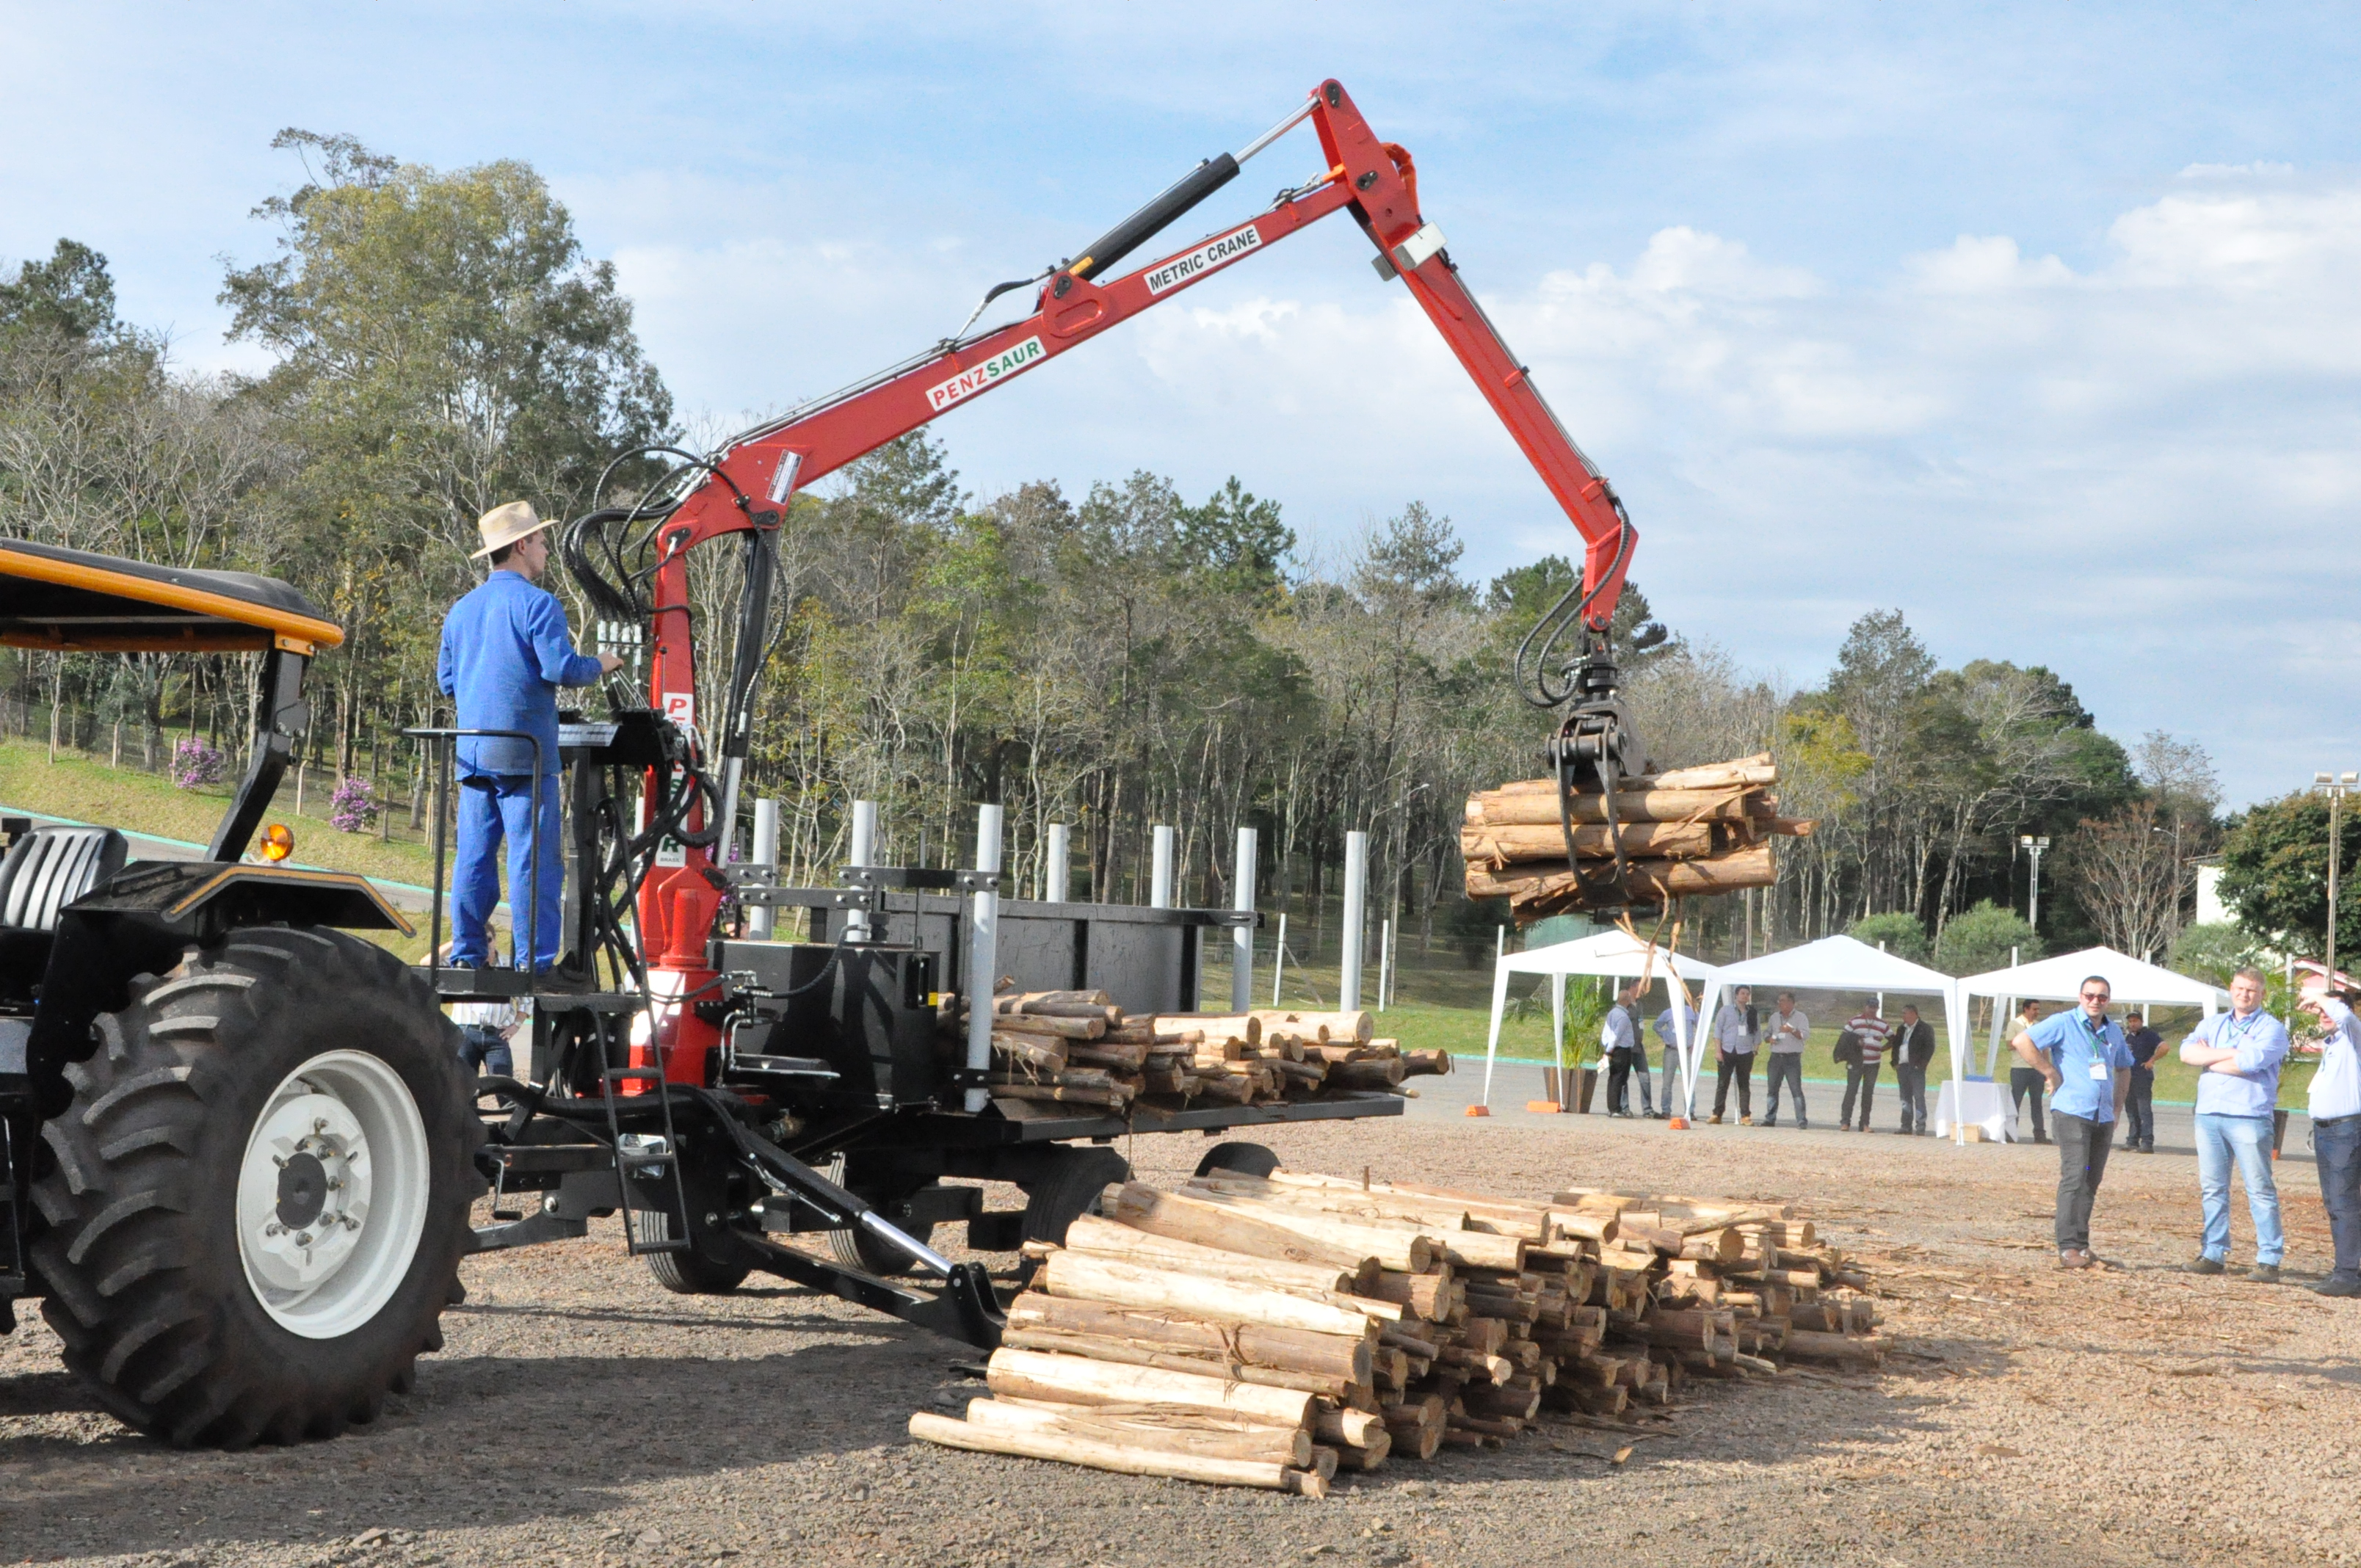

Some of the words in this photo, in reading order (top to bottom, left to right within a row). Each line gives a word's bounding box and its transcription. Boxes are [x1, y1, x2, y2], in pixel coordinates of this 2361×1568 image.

[1149, 254, 1204, 291] METRIC
[1208, 228, 1257, 261] CRANE
[933, 341, 1040, 407] PENZSAUR
